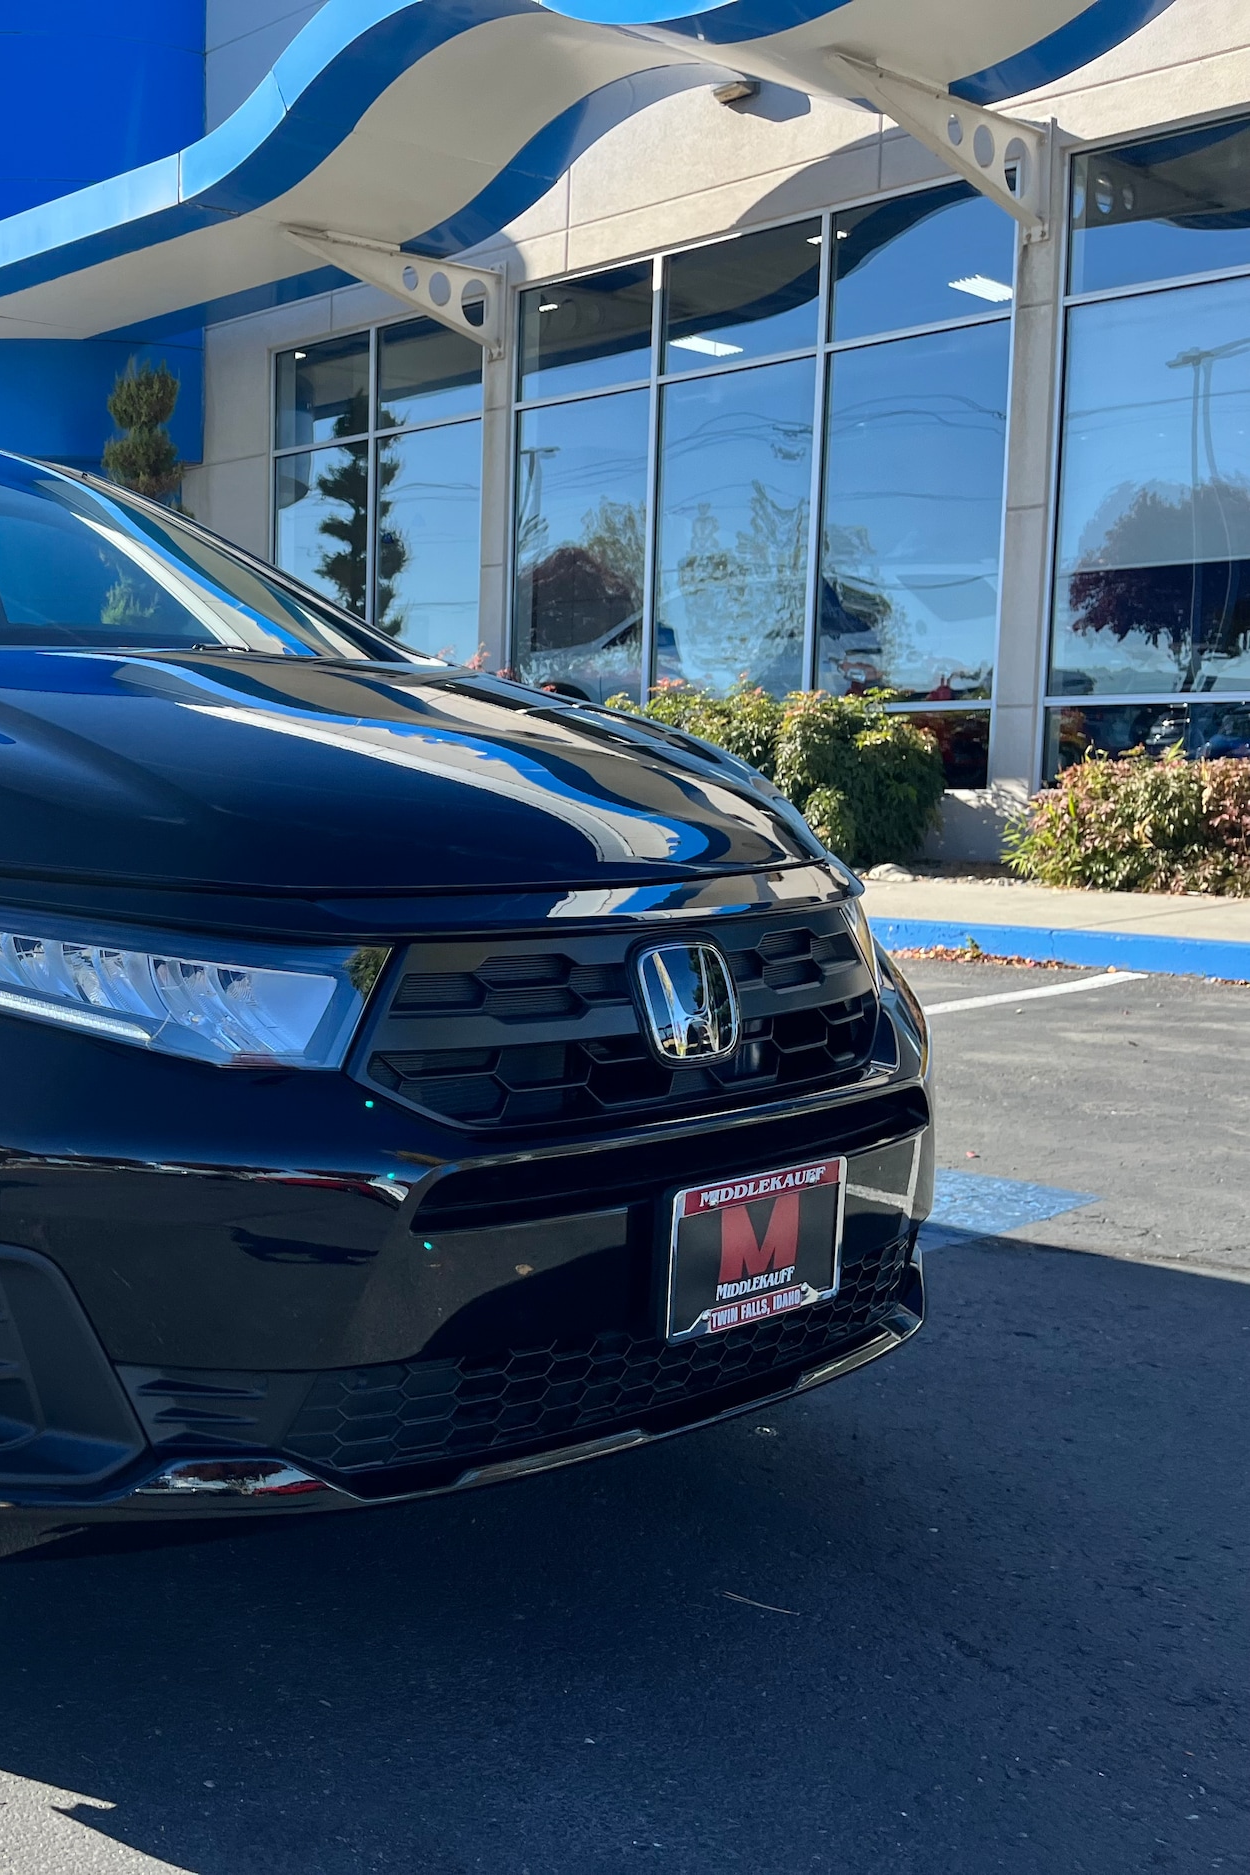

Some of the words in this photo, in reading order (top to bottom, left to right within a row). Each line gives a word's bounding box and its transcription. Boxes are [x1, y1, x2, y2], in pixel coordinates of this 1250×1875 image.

[699, 1166, 827, 1207] MIDDLEKAUFF
[718, 1192, 800, 1284] M
[715, 1265, 796, 1302] MIDDLEKAUFF
[711, 1306, 739, 1328] TWIN
[740, 1298, 770, 1320] FALLS,
[772, 1288, 802, 1310] IDAHO
